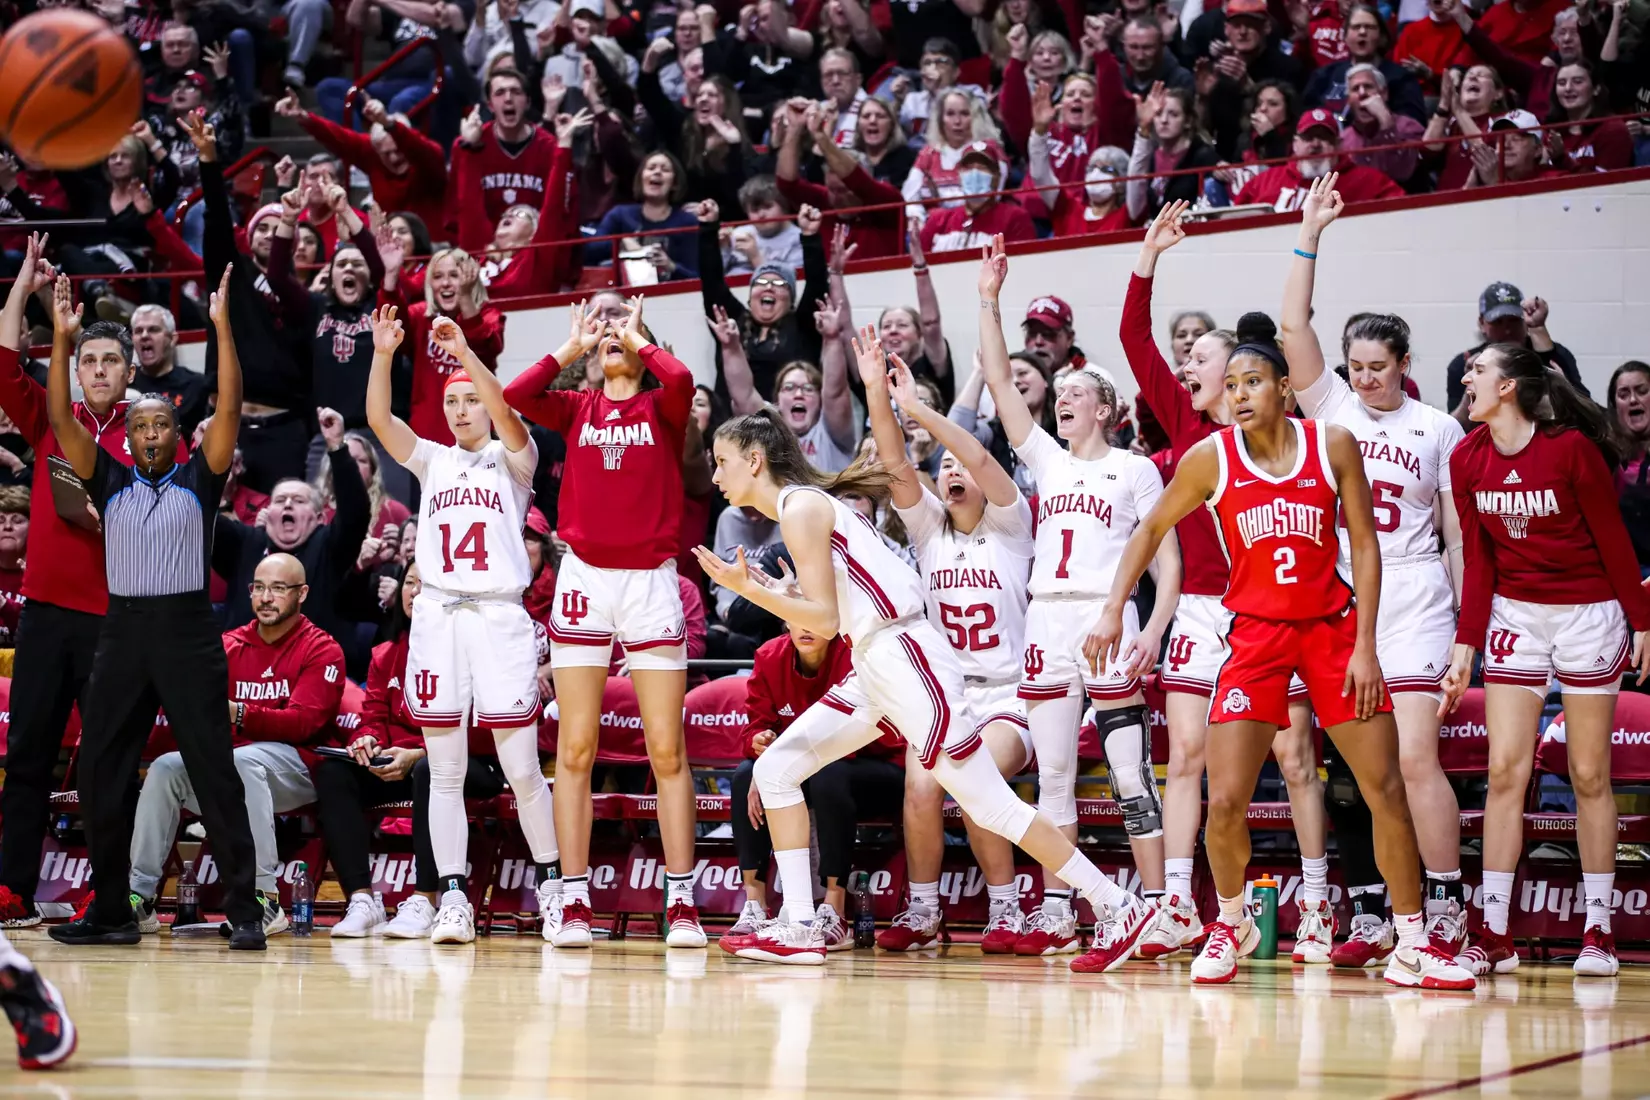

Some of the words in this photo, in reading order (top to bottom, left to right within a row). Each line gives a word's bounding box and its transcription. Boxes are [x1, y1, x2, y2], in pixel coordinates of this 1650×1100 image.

[482, 172, 543, 192] INDIANA
[1357, 440, 1421, 481] DIANA
[429, 487, 504, 518] INDIANA
[1039, 493, 1113, 529] INDIANA
[1475, 489, 1561, 517] INDIANA
[438, 521, 489, 573] 14
[1055, 528, 1074, 579] 1
[930, 568, 1003, 591] INDIANA
[1273, 546, 1298, 585] 2
[939, 601, 1000, 652] 52
[235, 679, 291, 701] INDIANA
